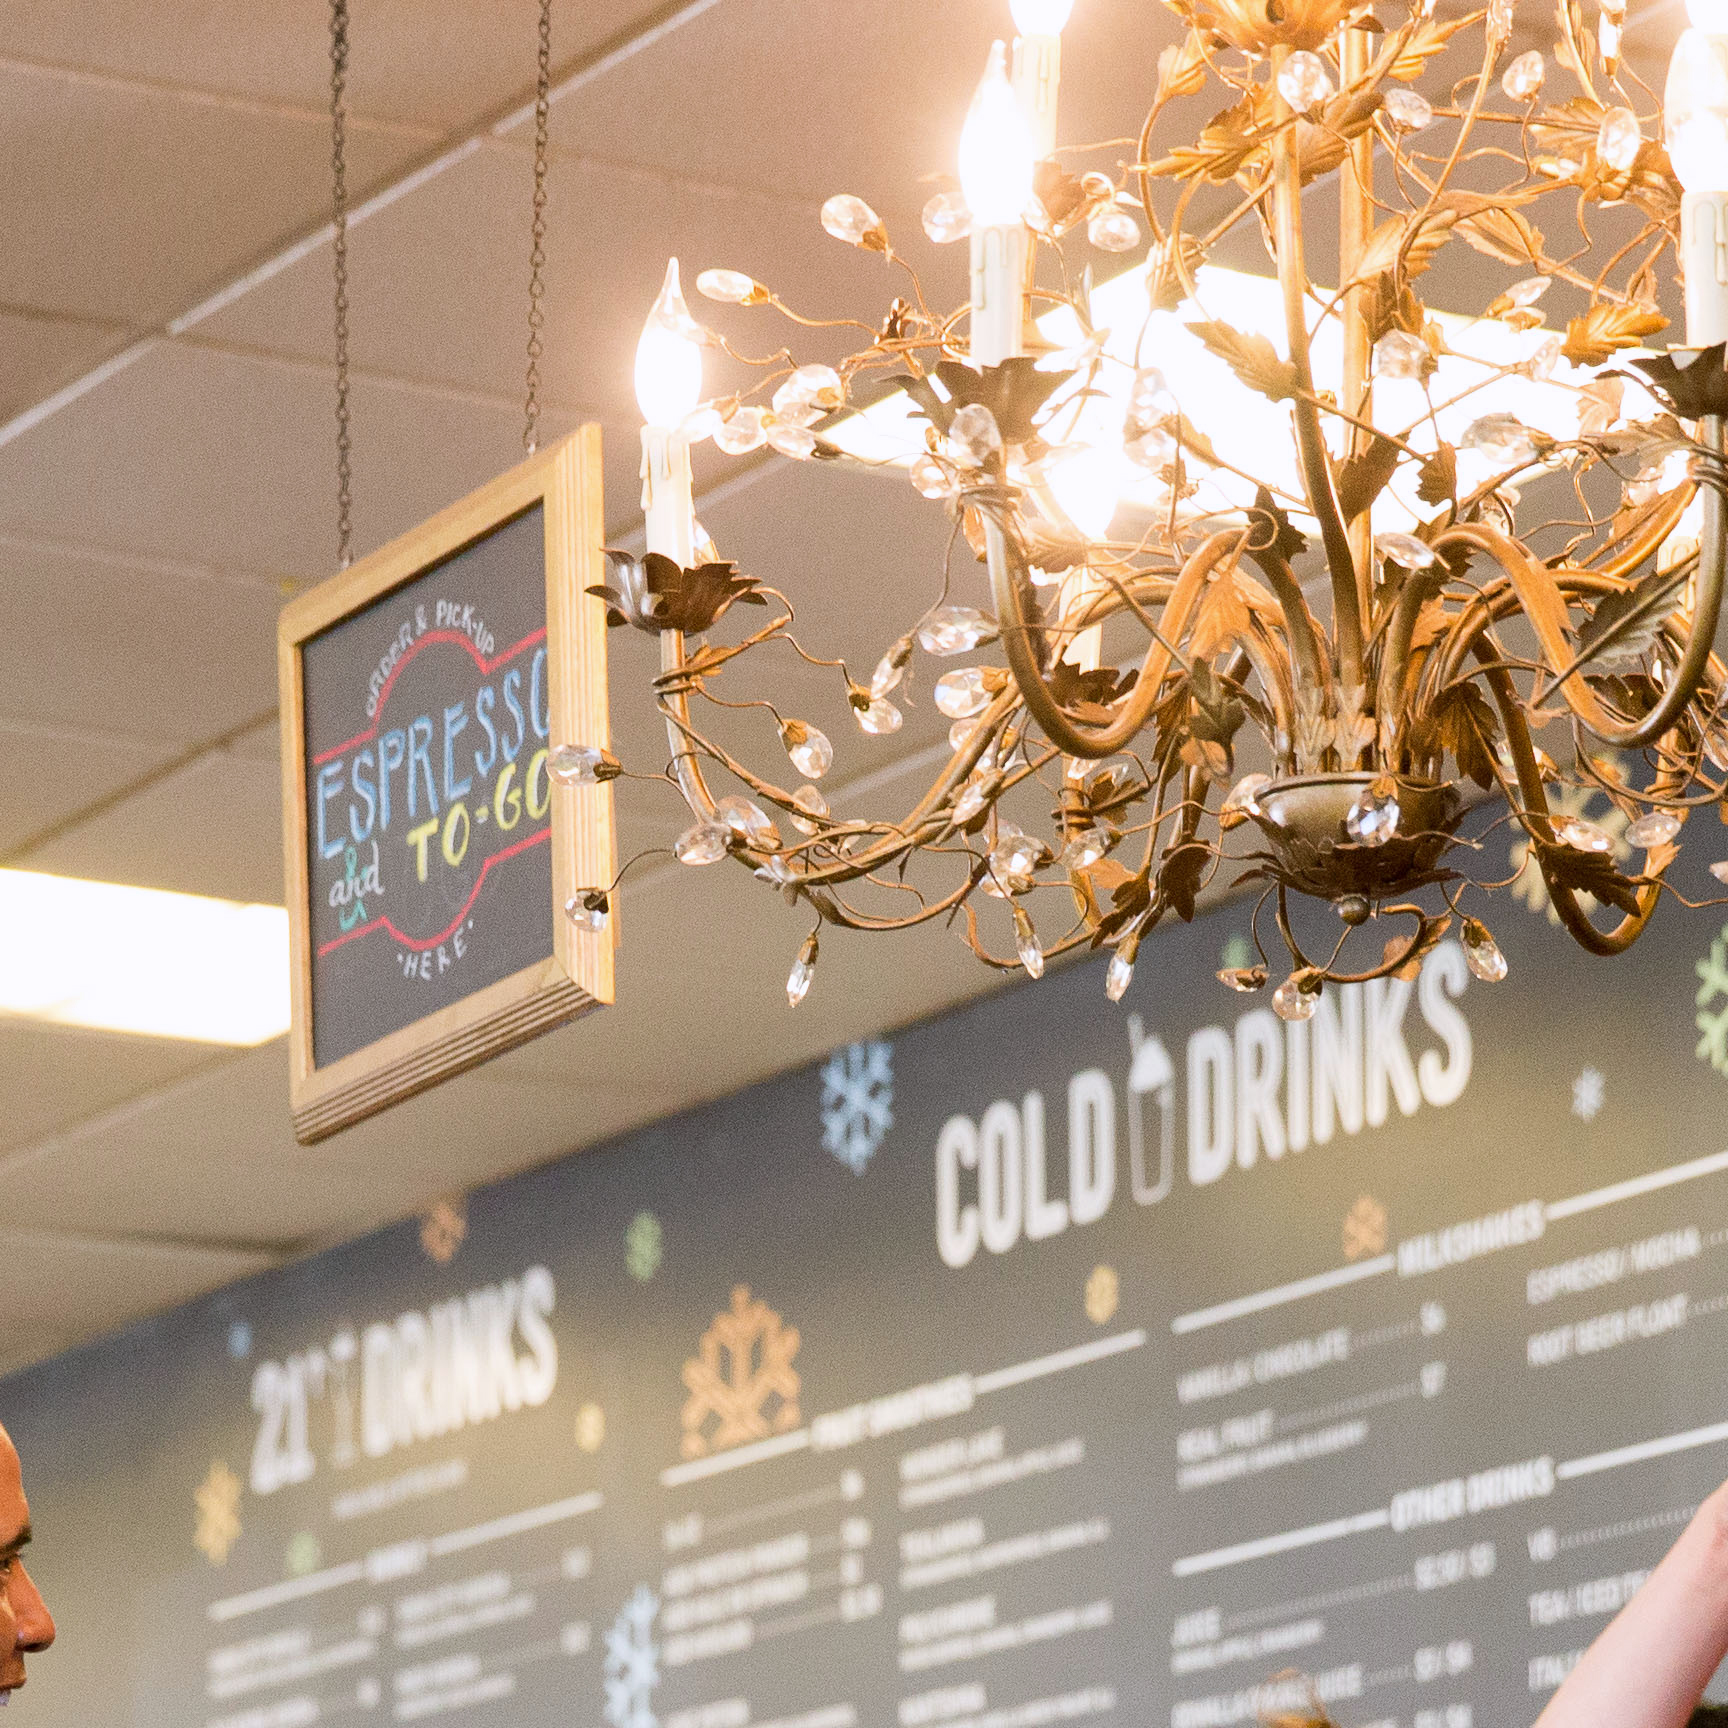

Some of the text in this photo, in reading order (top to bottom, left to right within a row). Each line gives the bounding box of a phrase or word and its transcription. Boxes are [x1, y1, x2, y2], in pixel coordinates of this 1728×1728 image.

[435, 598, 496, 656] PICK-UP
[328, 748, 552, 908] and TO-GO
[401, 925, 469, 981] HERE
[934, 940, 1474, 1268] COLD DRINKS
[1397, 1199, 1548, 1279] MILKSHAKES
[361, 1264, 559, 1458] DRINKS
[1465, 1454, 1556, 1515] DRINKS
